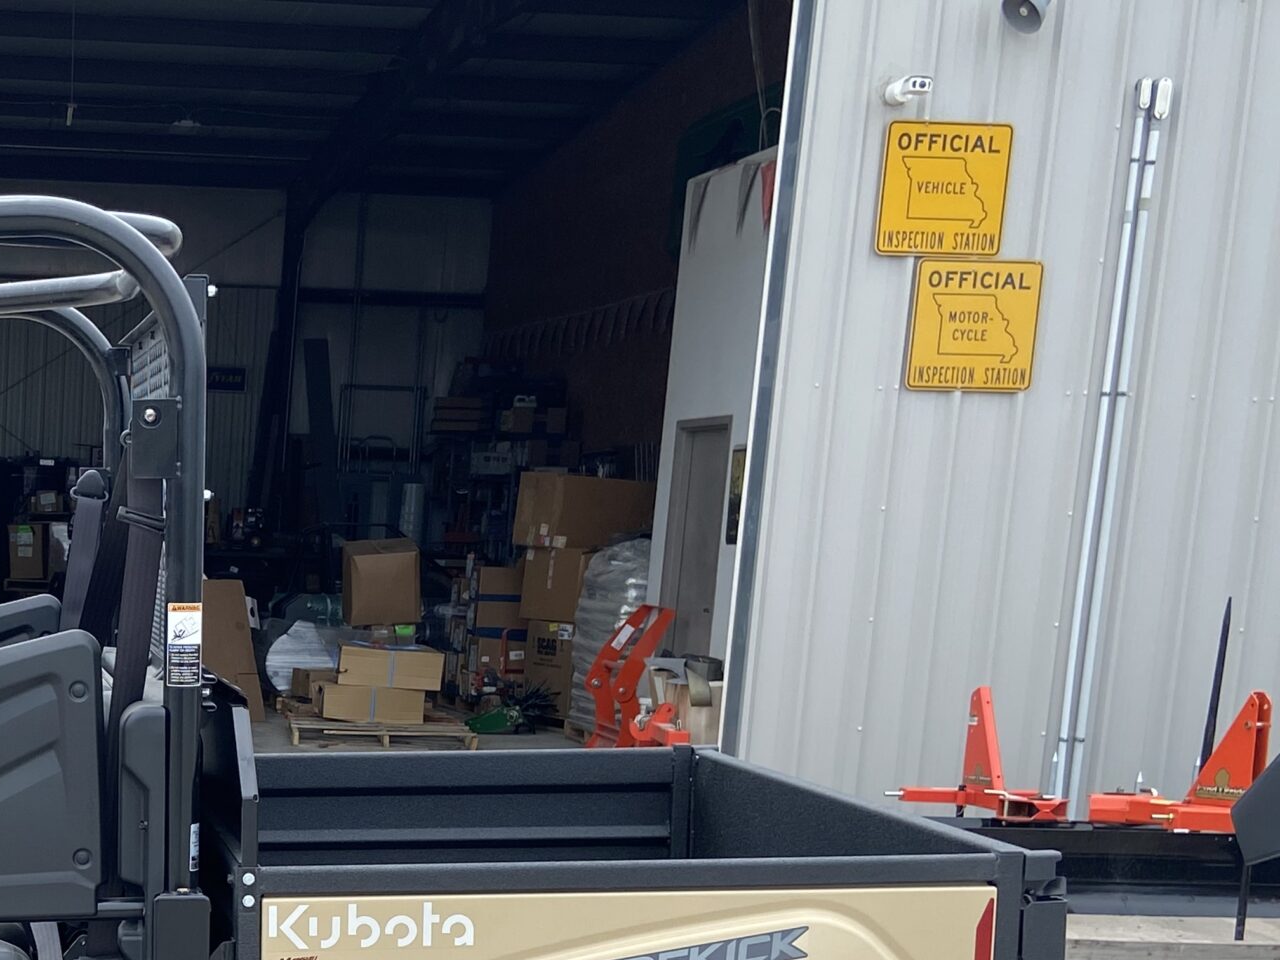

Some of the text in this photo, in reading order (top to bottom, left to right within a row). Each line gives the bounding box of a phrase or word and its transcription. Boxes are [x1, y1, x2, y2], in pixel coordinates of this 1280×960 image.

[898, 132, 1001, 154] OFFICIAL
[916, 181, 967, 195] VEHICLE
[882, 230, 996, 251] INSPECTION STATION
[928, 270, 1031, 290] OFFICIAL
[948, 311, 994, 324] MOTOR-
[952, 328, 988, 342] CYCLE
[912, 365, 1027, 385] INSPECTION STATION
[268, 901, 475, 950] Kubota
